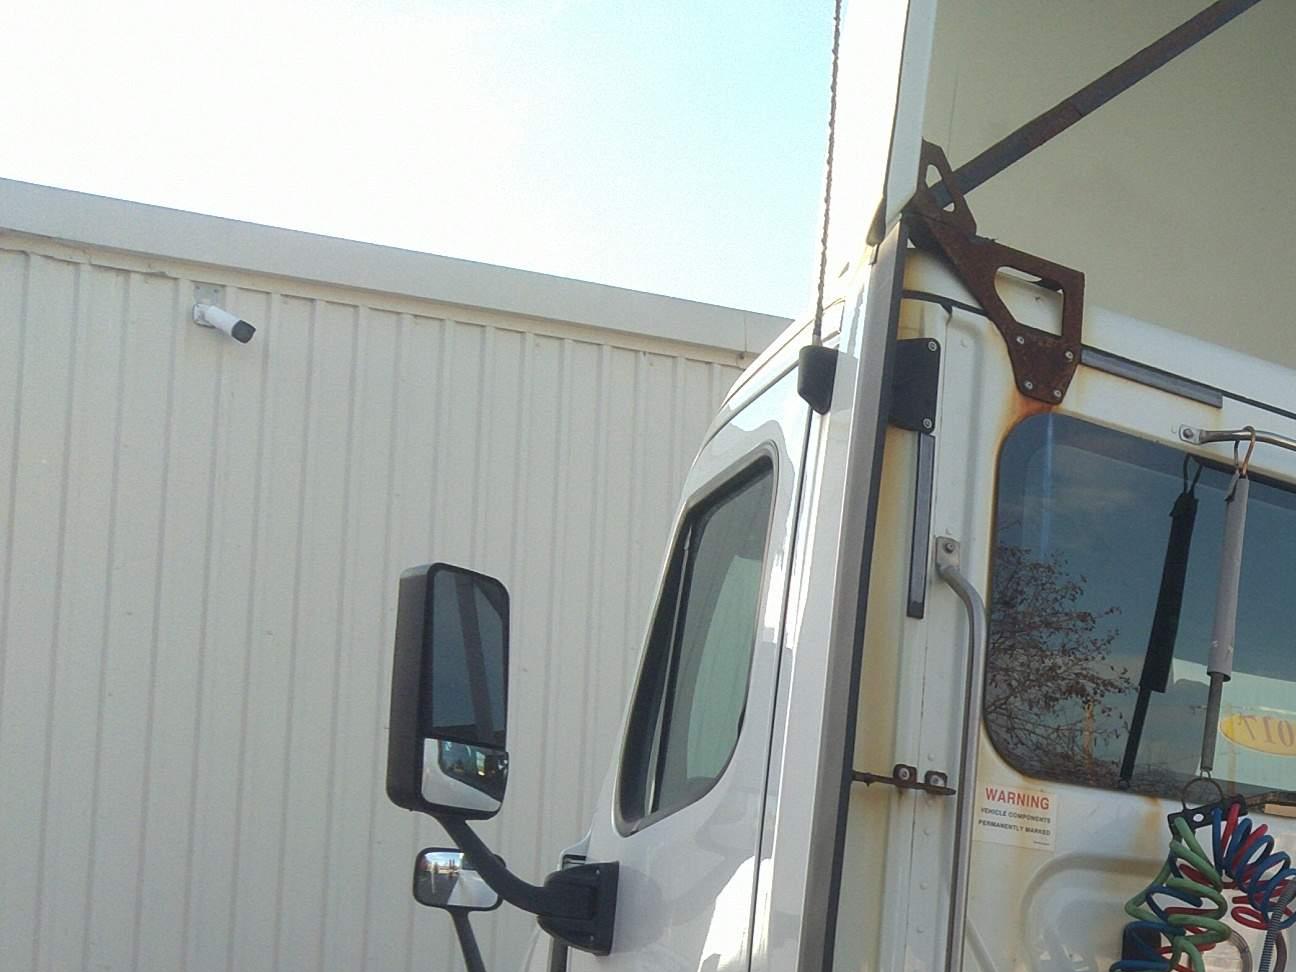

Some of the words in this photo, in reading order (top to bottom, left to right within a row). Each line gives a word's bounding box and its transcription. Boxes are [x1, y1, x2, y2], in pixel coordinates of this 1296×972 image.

[985, 787, 1050, 810] WARNING
[981, 807, 1007, 817] VEHICLE
[1008, 811, 1051, 824] COMPONENTS
[978, 819, 1024, 832] PERMANENTLY
[1025, 826, 1051, 836] MARKED
